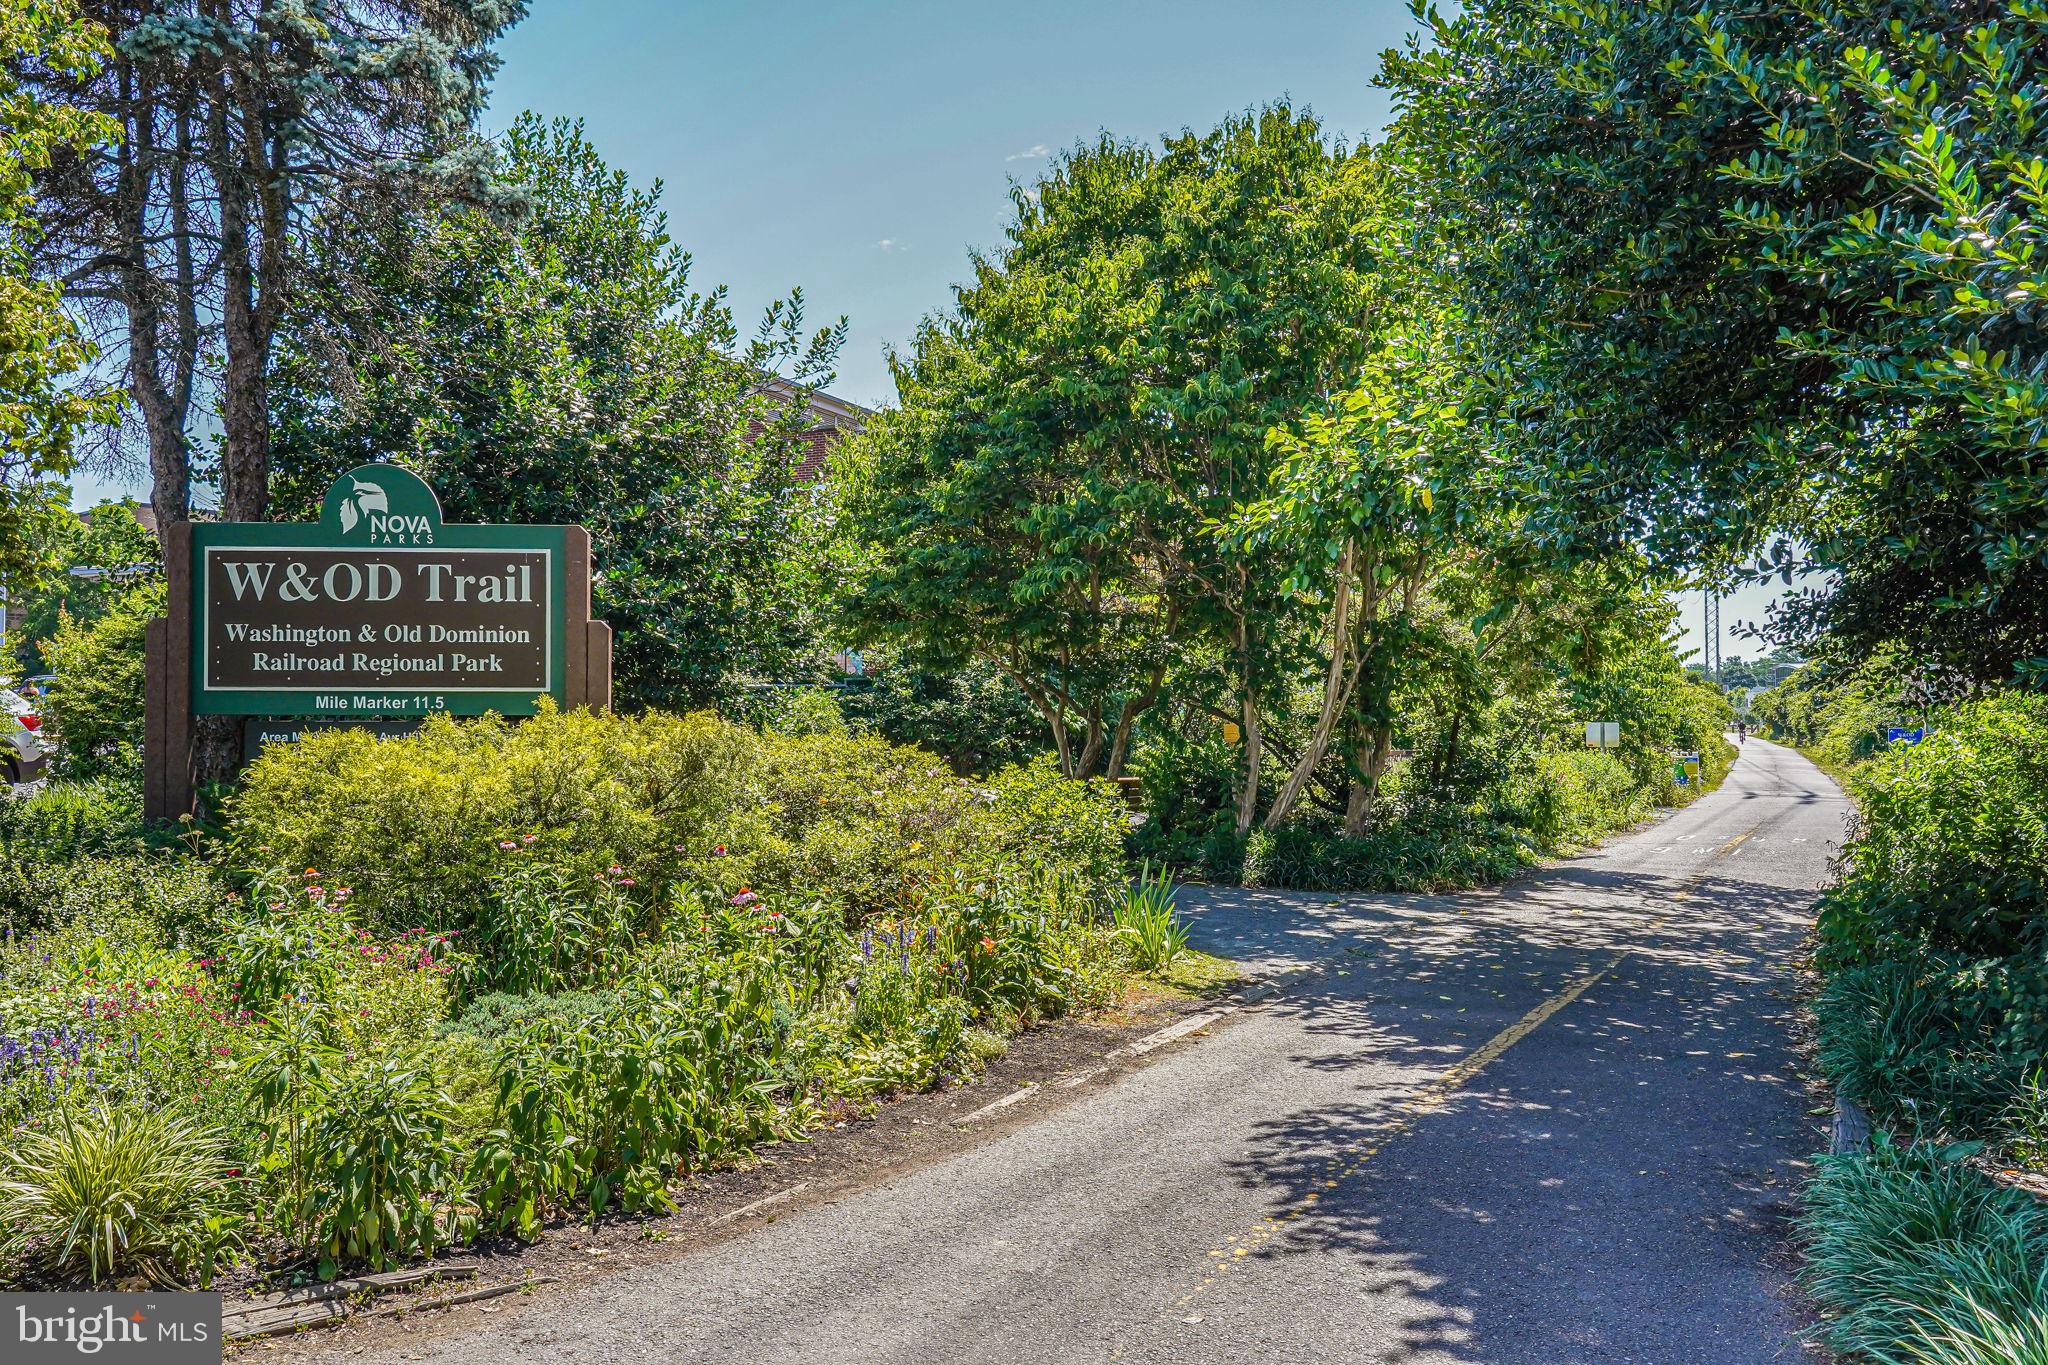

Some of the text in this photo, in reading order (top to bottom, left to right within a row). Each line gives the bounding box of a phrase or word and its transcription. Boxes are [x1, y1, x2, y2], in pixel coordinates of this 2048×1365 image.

[371, 515, 432, 533] NOVA
[371, 534, 433, 544] PARKS
[222, 562, 532, 602] W&OD Trail
[225, 623, 530, 647] Washington & Old Dominion
[252, 652, 503, 676] Railroad Regional Park
[315, 696, 445, 709] Mile Marker 11.5
[260, 731, 289, 742] Area
